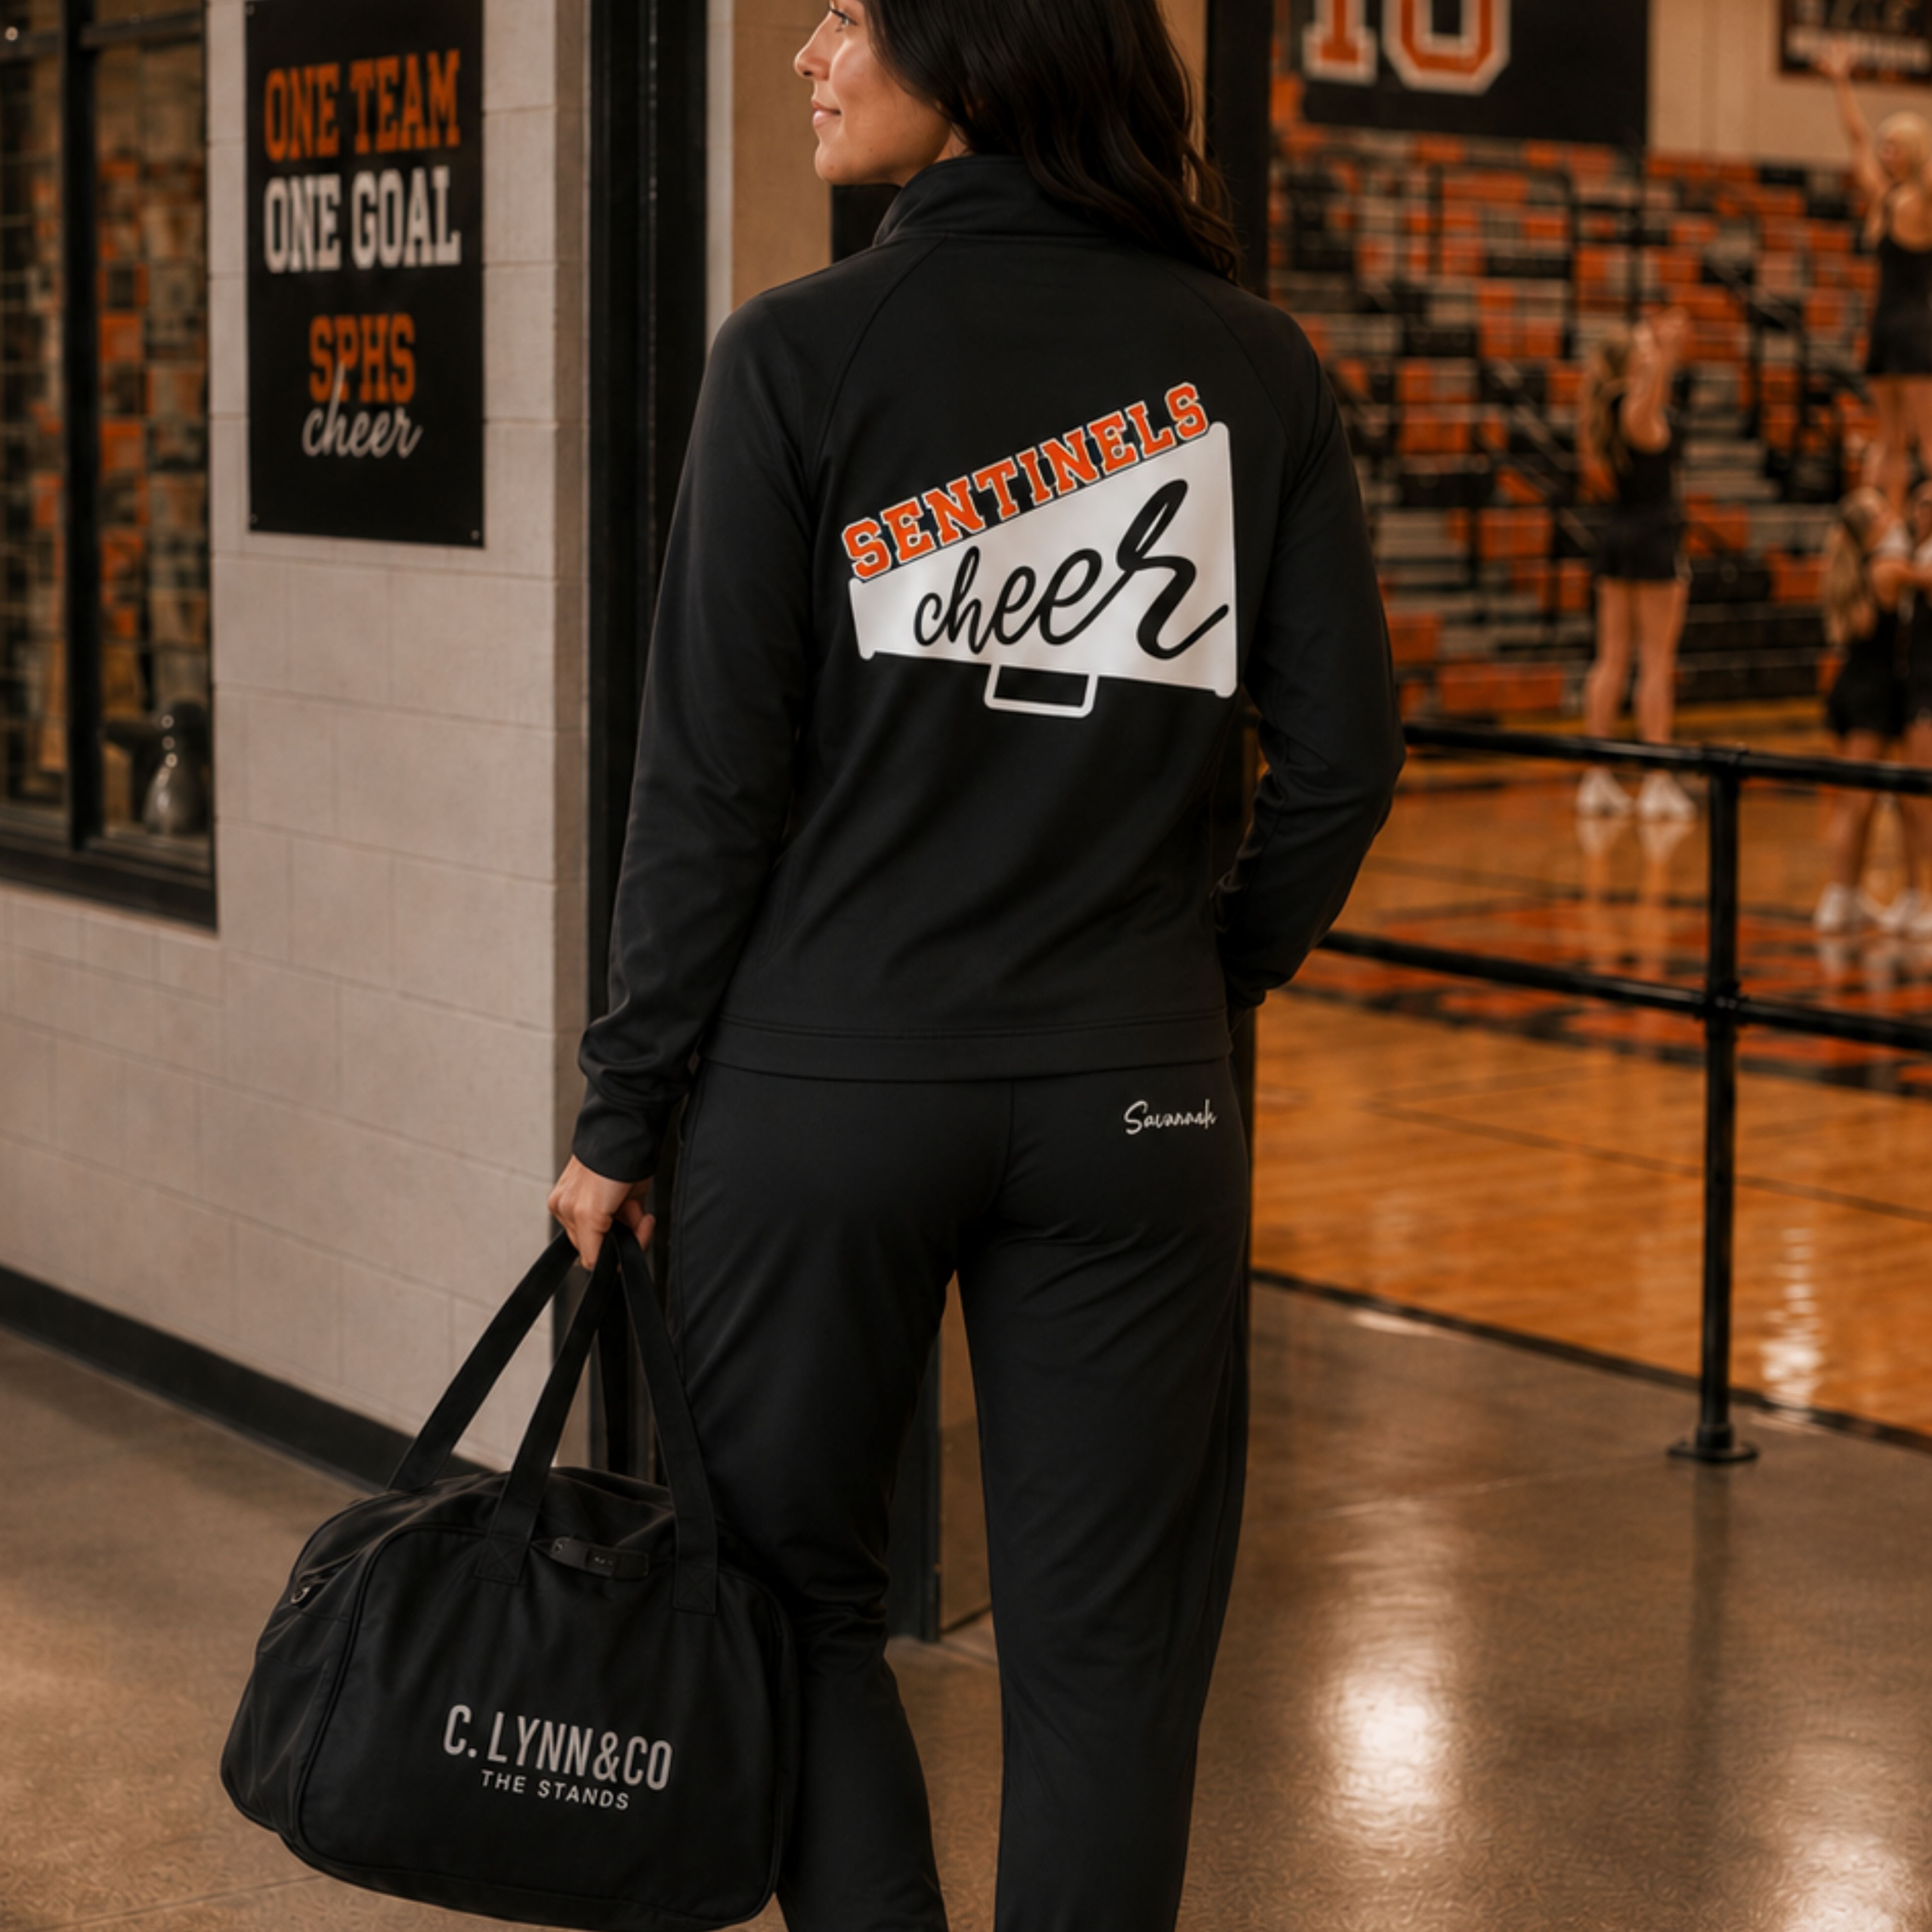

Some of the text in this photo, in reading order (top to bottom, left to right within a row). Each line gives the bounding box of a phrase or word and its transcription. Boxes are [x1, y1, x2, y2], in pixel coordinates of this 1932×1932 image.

[265, 50, 459, 162] ONE TEAM
[264, 165, 461, 273] ONE GOAL
[303, 361, 422, 457] cheer
[310, 313, 415, 403] SPHS
[842, 382, 1209, 579] SENTINELS
[913, 479, 1229, 660] cheer
[481, 1769, 629, 1810] THE STANDS
[487, 1711, 673, 1790] LYNN&CO
